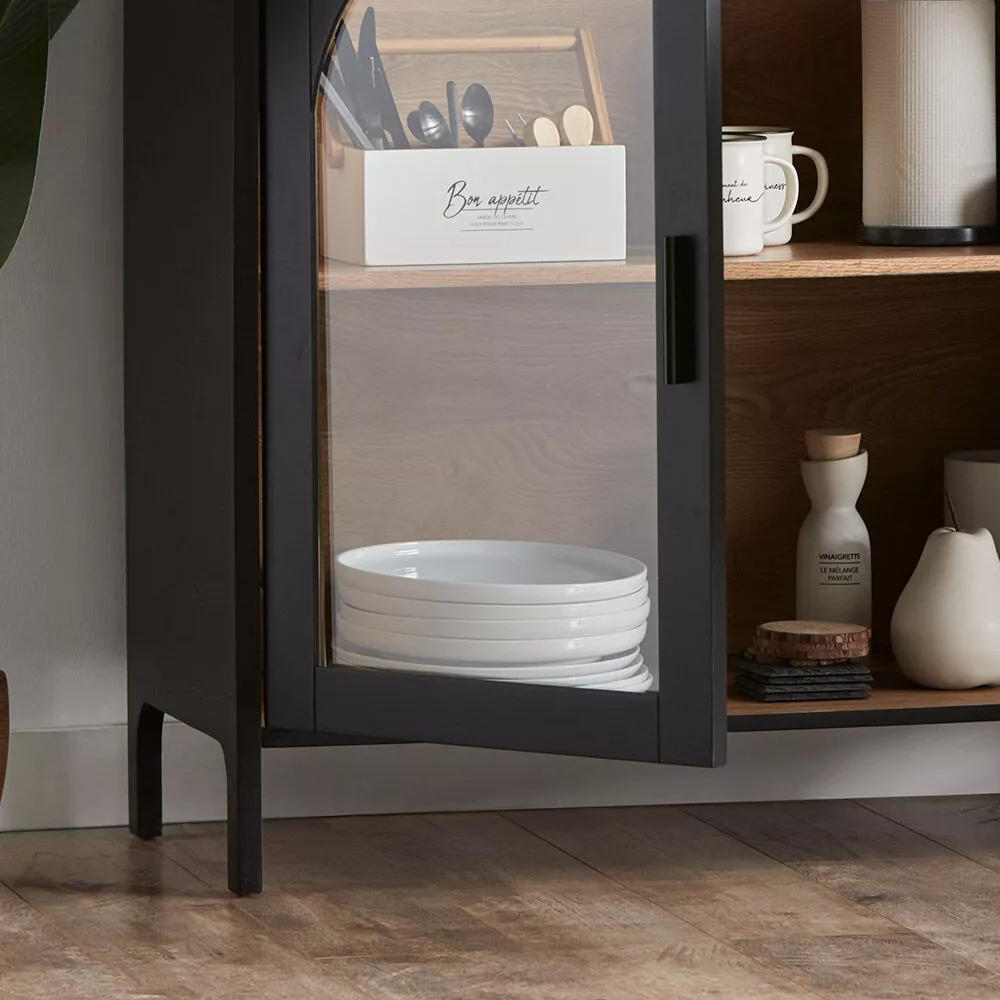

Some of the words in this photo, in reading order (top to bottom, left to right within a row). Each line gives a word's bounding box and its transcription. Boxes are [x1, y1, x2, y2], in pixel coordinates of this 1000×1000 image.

[443, 180, 482, 219] Bon
[488, 185, 549, 217] appétit
[818, 553, 861, 561] VINAIGRETTE
